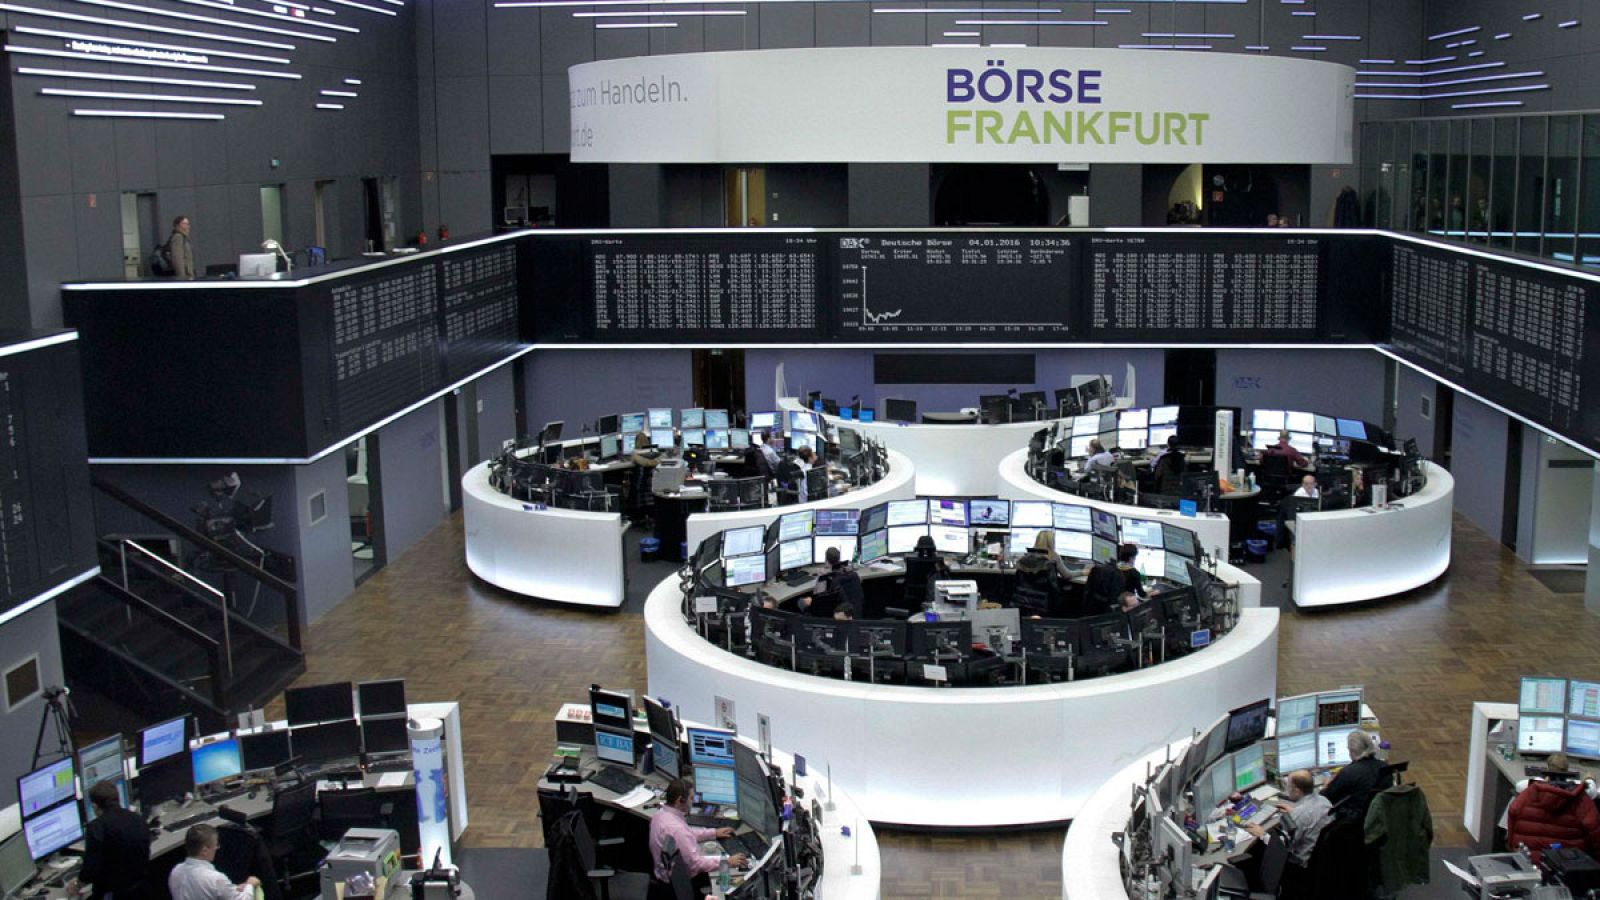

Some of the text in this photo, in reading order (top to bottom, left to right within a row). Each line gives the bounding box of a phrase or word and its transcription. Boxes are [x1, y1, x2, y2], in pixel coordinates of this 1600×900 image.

[600, 74, 688, 105] Handeln.
[947, 60, 1102, 104] BÖRSE
[947, 110, 1210, 145] FRANKFURT
